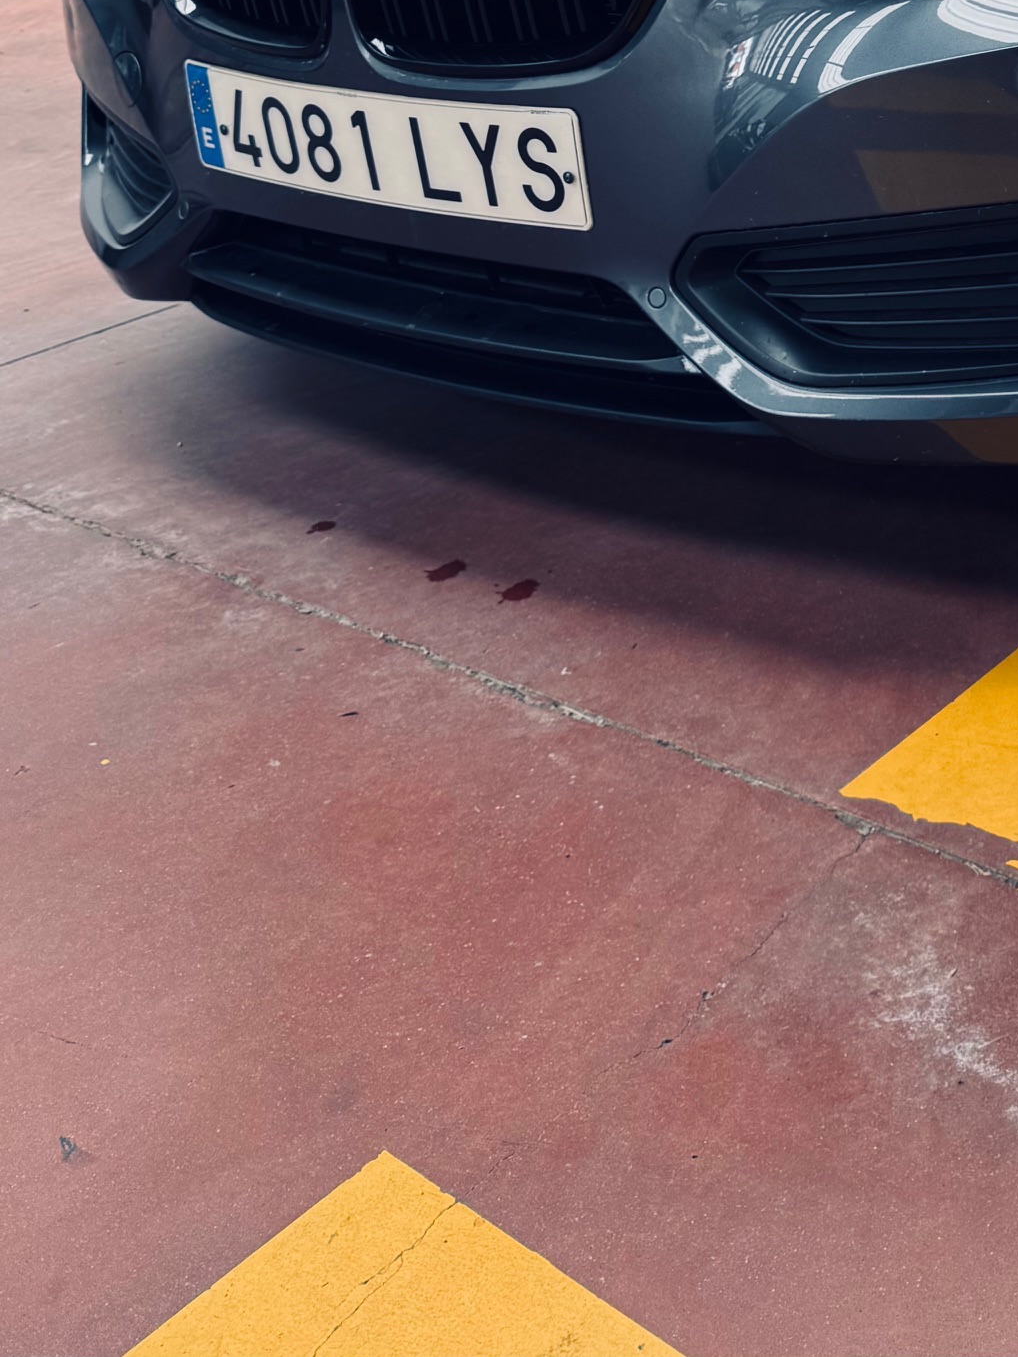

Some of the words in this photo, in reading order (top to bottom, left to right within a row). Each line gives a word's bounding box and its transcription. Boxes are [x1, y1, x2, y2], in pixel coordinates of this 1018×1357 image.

[200, 126, 216, 149] E
[233, 89, 381, 192] 4081
[408, 116, 566, 213] LYS
